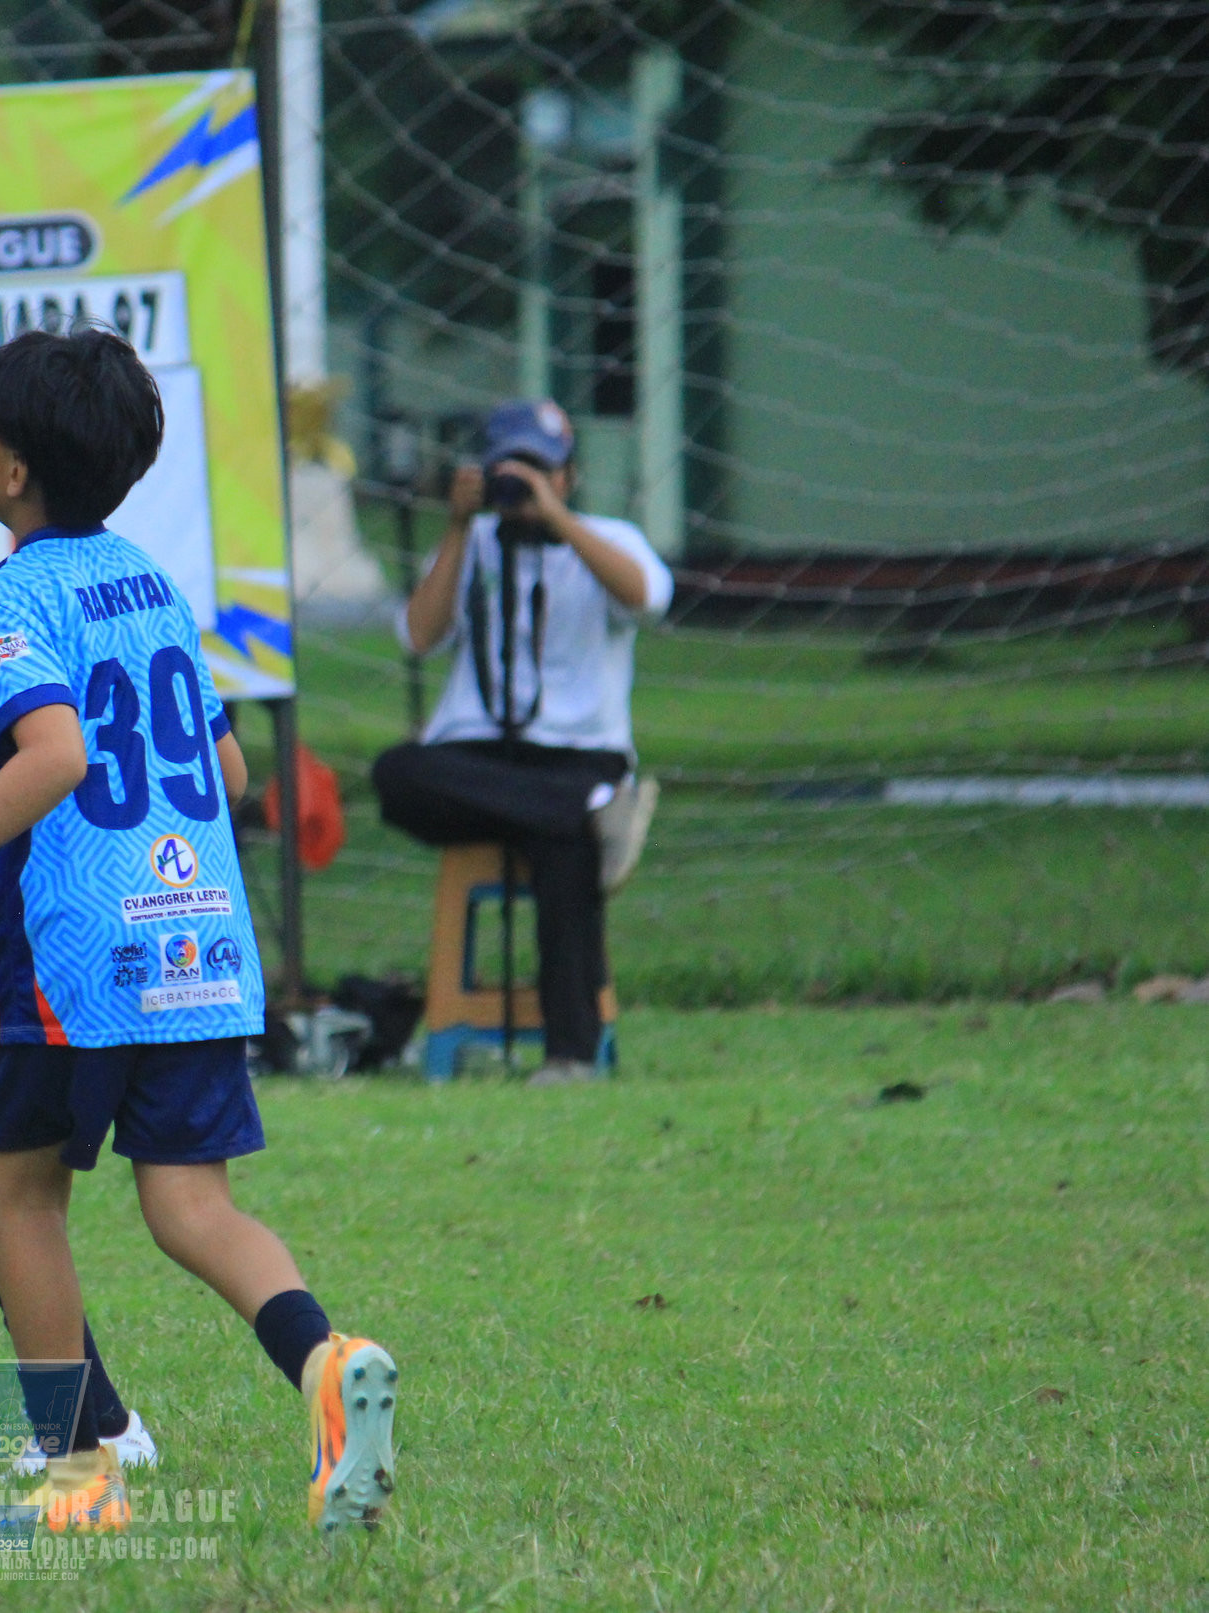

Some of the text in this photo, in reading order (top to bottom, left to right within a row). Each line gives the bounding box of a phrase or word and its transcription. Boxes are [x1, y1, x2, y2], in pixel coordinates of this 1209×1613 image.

[114, 288, 159, 352] 97
[74, 645, 220, 831] 39
[124, 891, 195, 911] CV.ANGGREK
[164, 967, 200, 979] RAN
